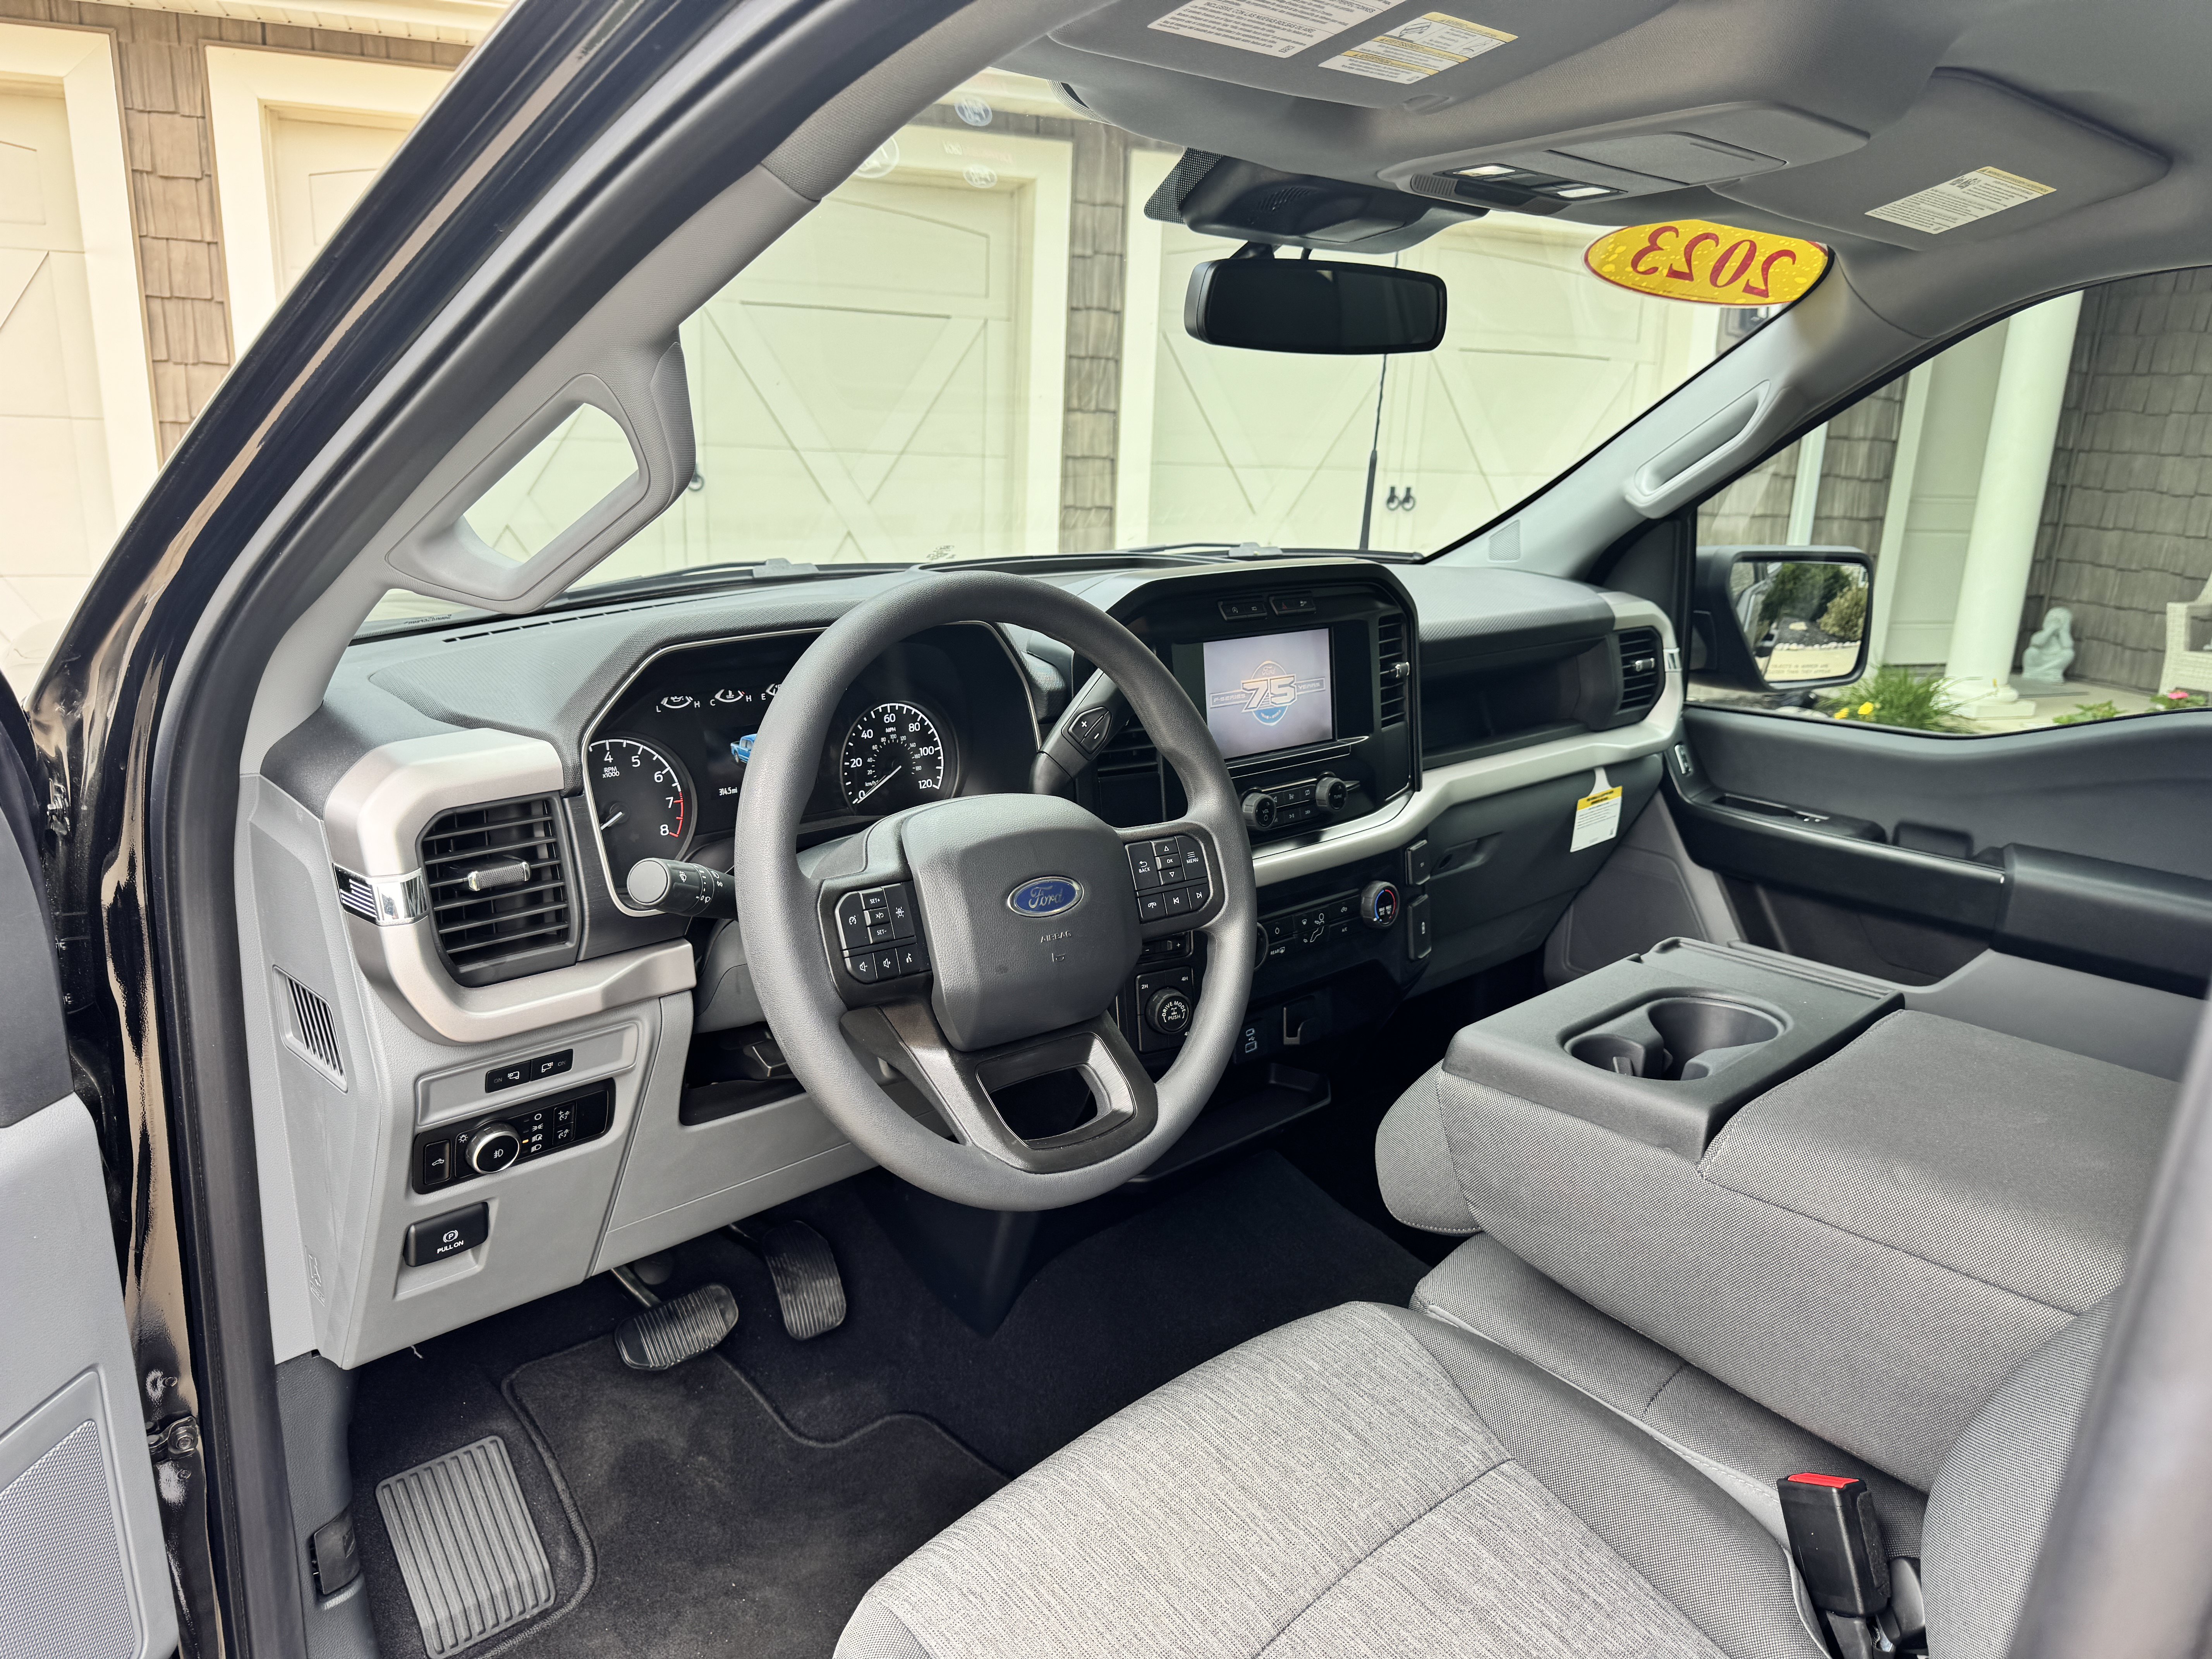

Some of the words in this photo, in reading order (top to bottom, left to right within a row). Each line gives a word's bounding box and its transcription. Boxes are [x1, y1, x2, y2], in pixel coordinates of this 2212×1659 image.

[1262, 666, 1275, 675] Ford
[1213, 694, 1246, 703] F-SERIES
[1241, 674, 1297, 713] 75
[884, 713, 896, 723] 60
[908, 722, 921, 732] 80
[861, 729, 873, 739] 40
[604, 751, 613, 763] 4
[919, 746, 934, 757] 100
[631, 755, 641, 768] 5
[850, 757, 862, 768] 20
[654, 771, 664, 783] 6
[918, 779, 933, 790] 120
[858, 790, 866, 799] 0
[665, 796, 674, 809] 7
[660, 824, 670, 836] 8
[1028, 885, 1065, 909] Ford
[1041, 930, 1072, 943] AIRBAG
[1162, 1001, 1173, 1017] DRIVE
[1173, 1000, 1186, 1013] MODE
[437, 1244, 453, 1254] PULL
